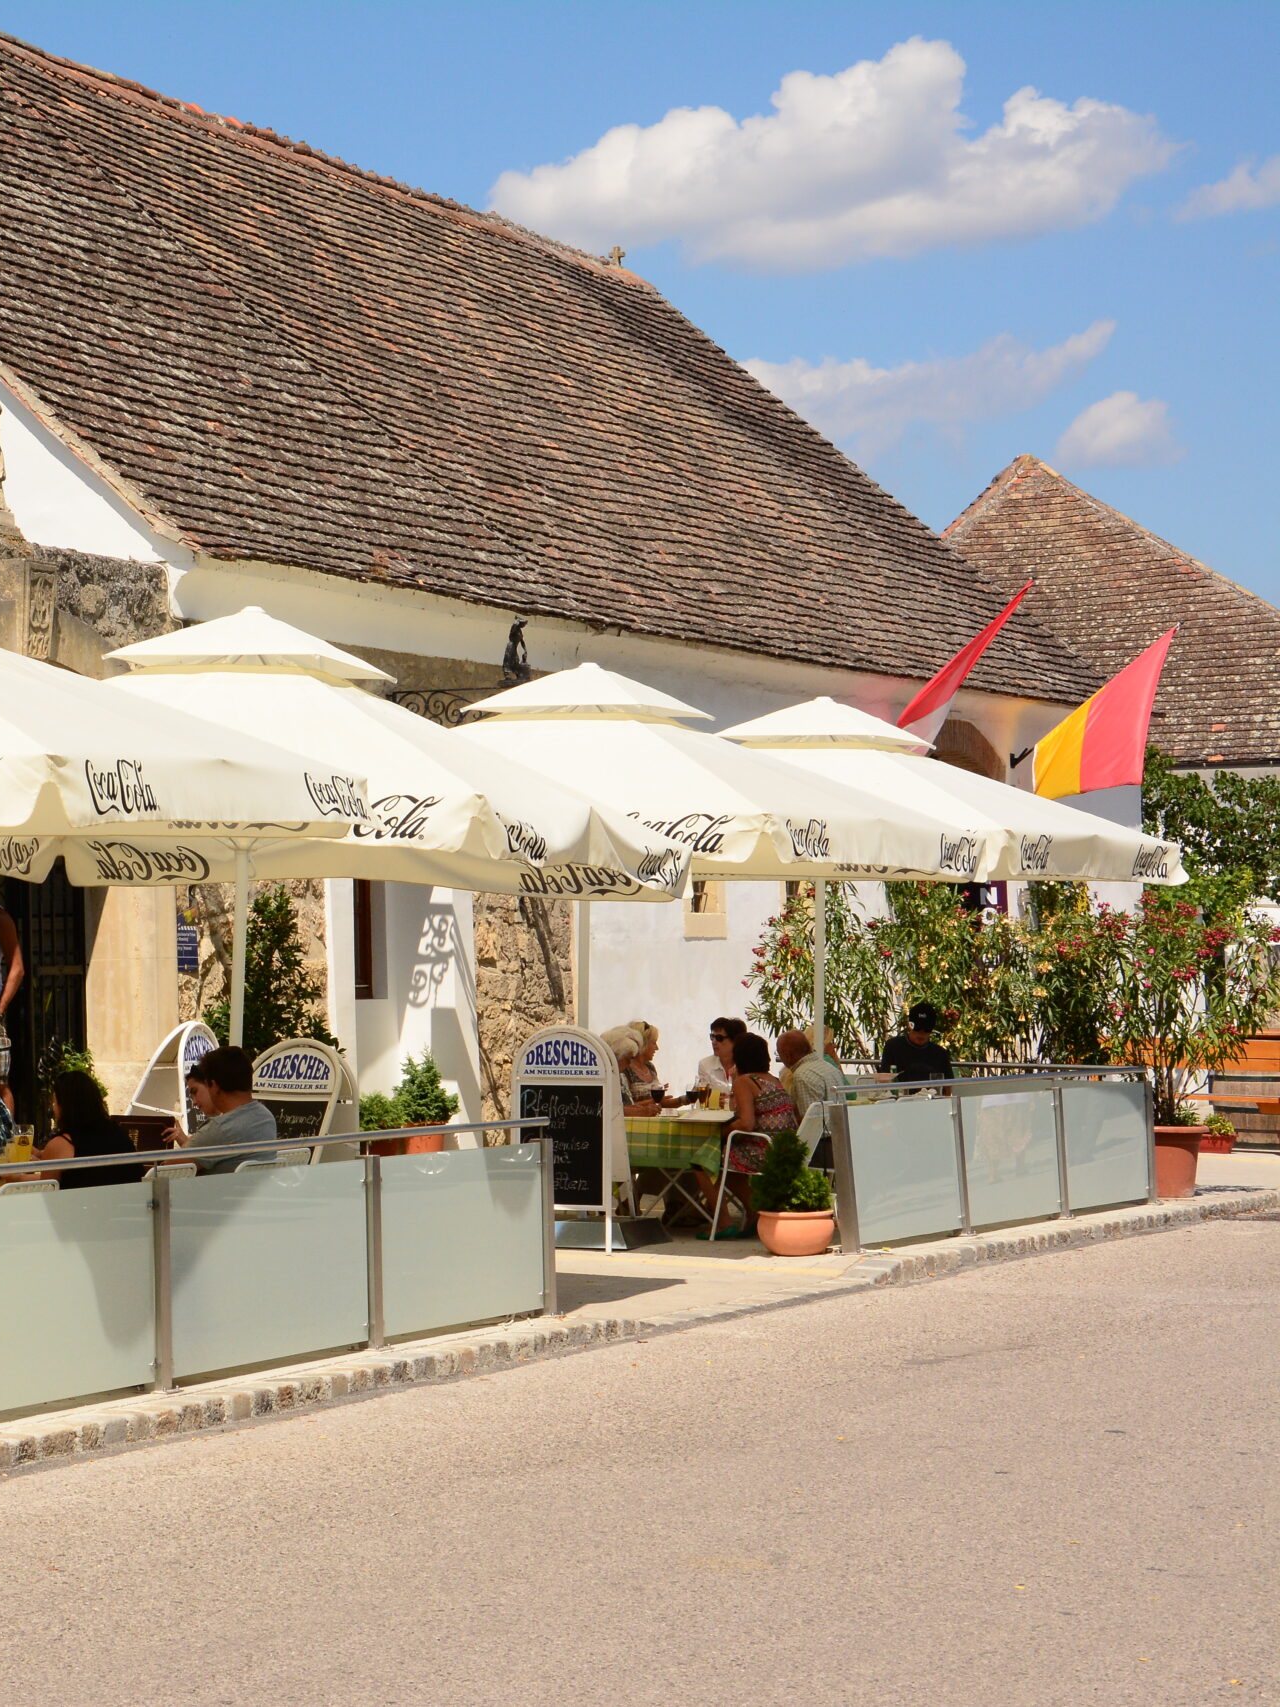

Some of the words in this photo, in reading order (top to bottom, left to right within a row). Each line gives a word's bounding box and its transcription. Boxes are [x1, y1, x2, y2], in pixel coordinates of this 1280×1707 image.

[85, 759, 158, 815] Coca-Cola
[304, 772, 368, 820] Coca-Cola
[786, 819, 830, 857] Coca-Cola
[258, 1054, 330, 1080] DRESCHER
[526, 1040, 598, 1066] DRESCHER
